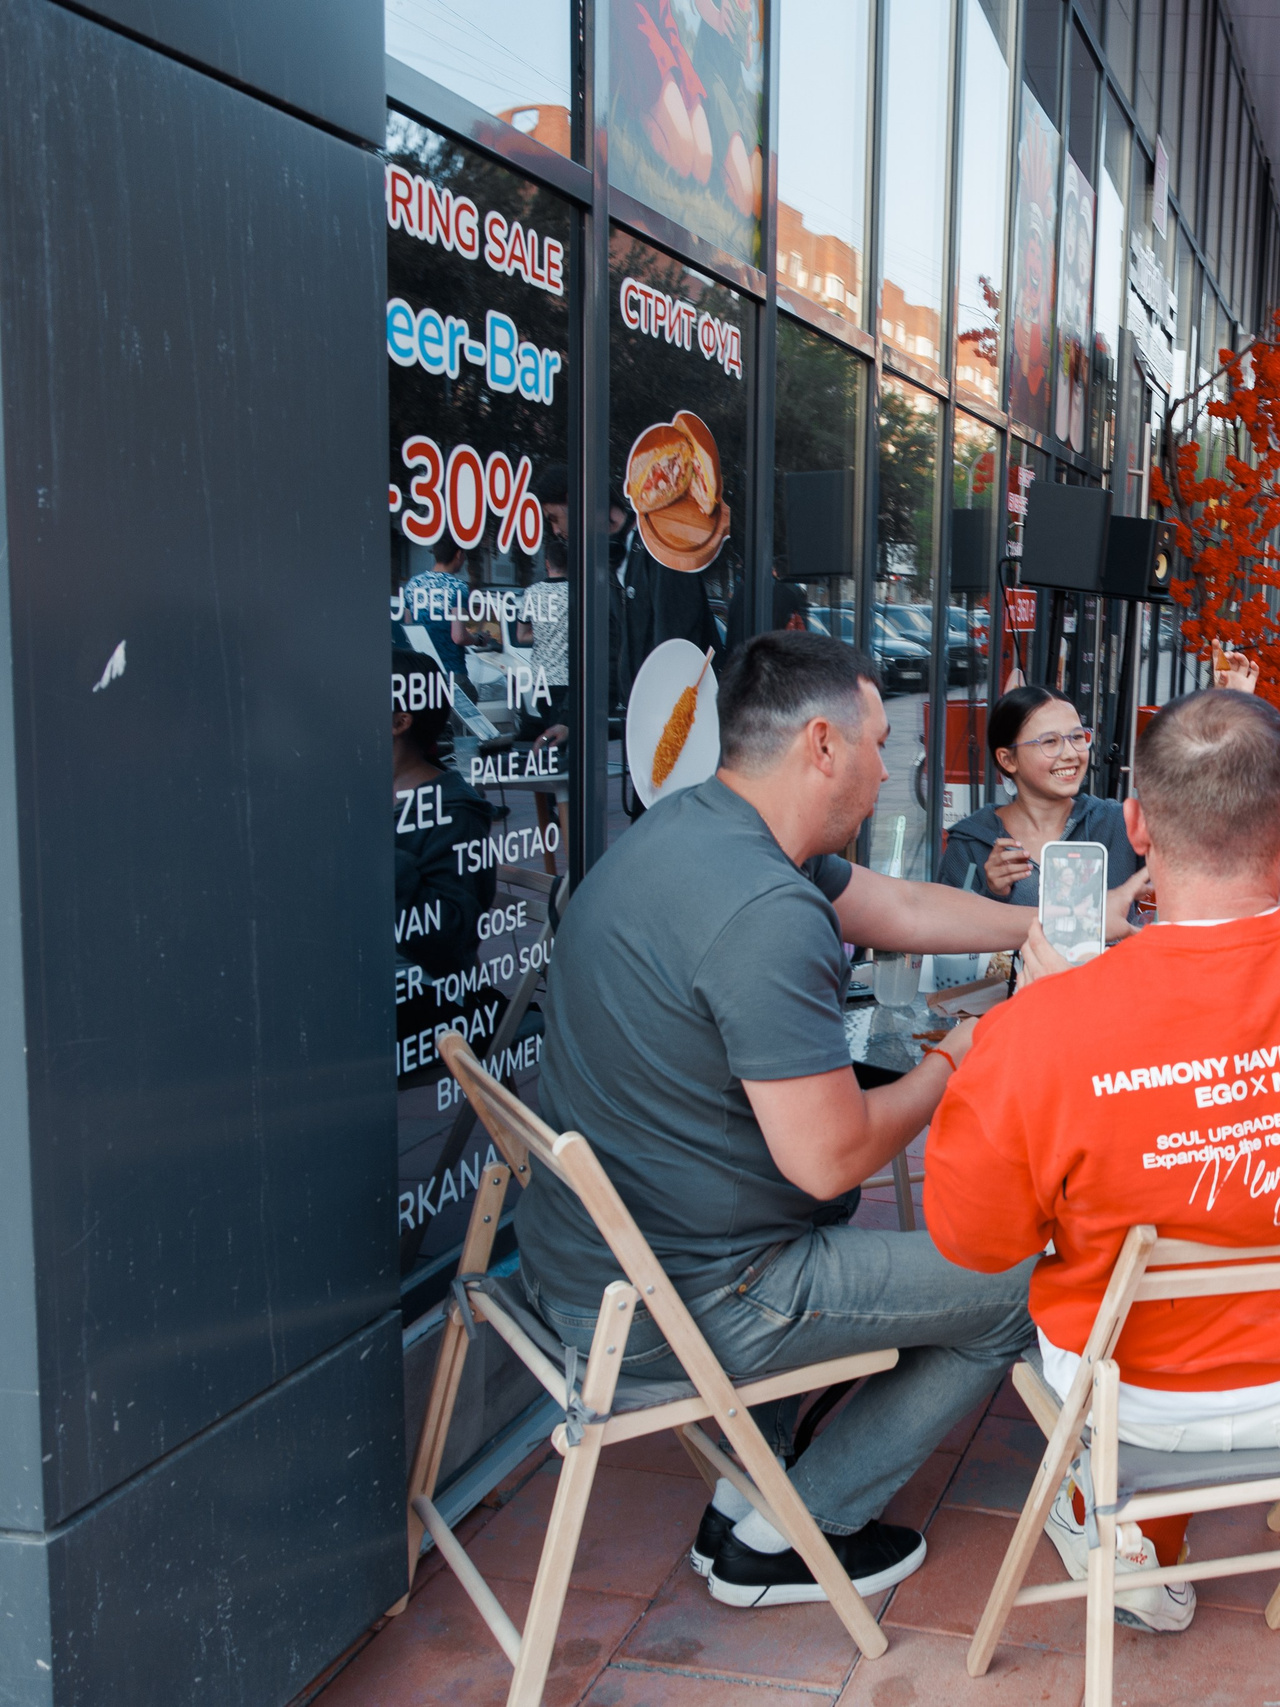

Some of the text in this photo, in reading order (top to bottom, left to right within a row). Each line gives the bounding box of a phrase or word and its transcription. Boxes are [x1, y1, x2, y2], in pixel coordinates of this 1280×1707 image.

[486, 214, 562, 292] SALE
[623, 281, 741, 377] СТРИТ ФУД
[387, 301, 559, 403] eer-Bar
[413, 587, 517, 622] PELLONG
[521, 593, 559, 623] ALE
[391, 670, 455, 712] RBIN
[507, 665, 552, 710] IPA
[470, 746, 559, 787] PALE ALE
[396, 784, 453, 834] ZEL
[452, 822, 560, 876] TSINGTAO
[477, 900, 528, 941] GOSE
[431, 953, 514, 1007] TOMATO
[1092, 1056, 1229, 1097] HARMONY
[1194, 1084, 1248, 1109] EGO
[1142, 1144, 1236, 1170] Expanding
[1238, 1137, 1262, 1155] the
[1156, 1130, 1206, 1150] SOUL
